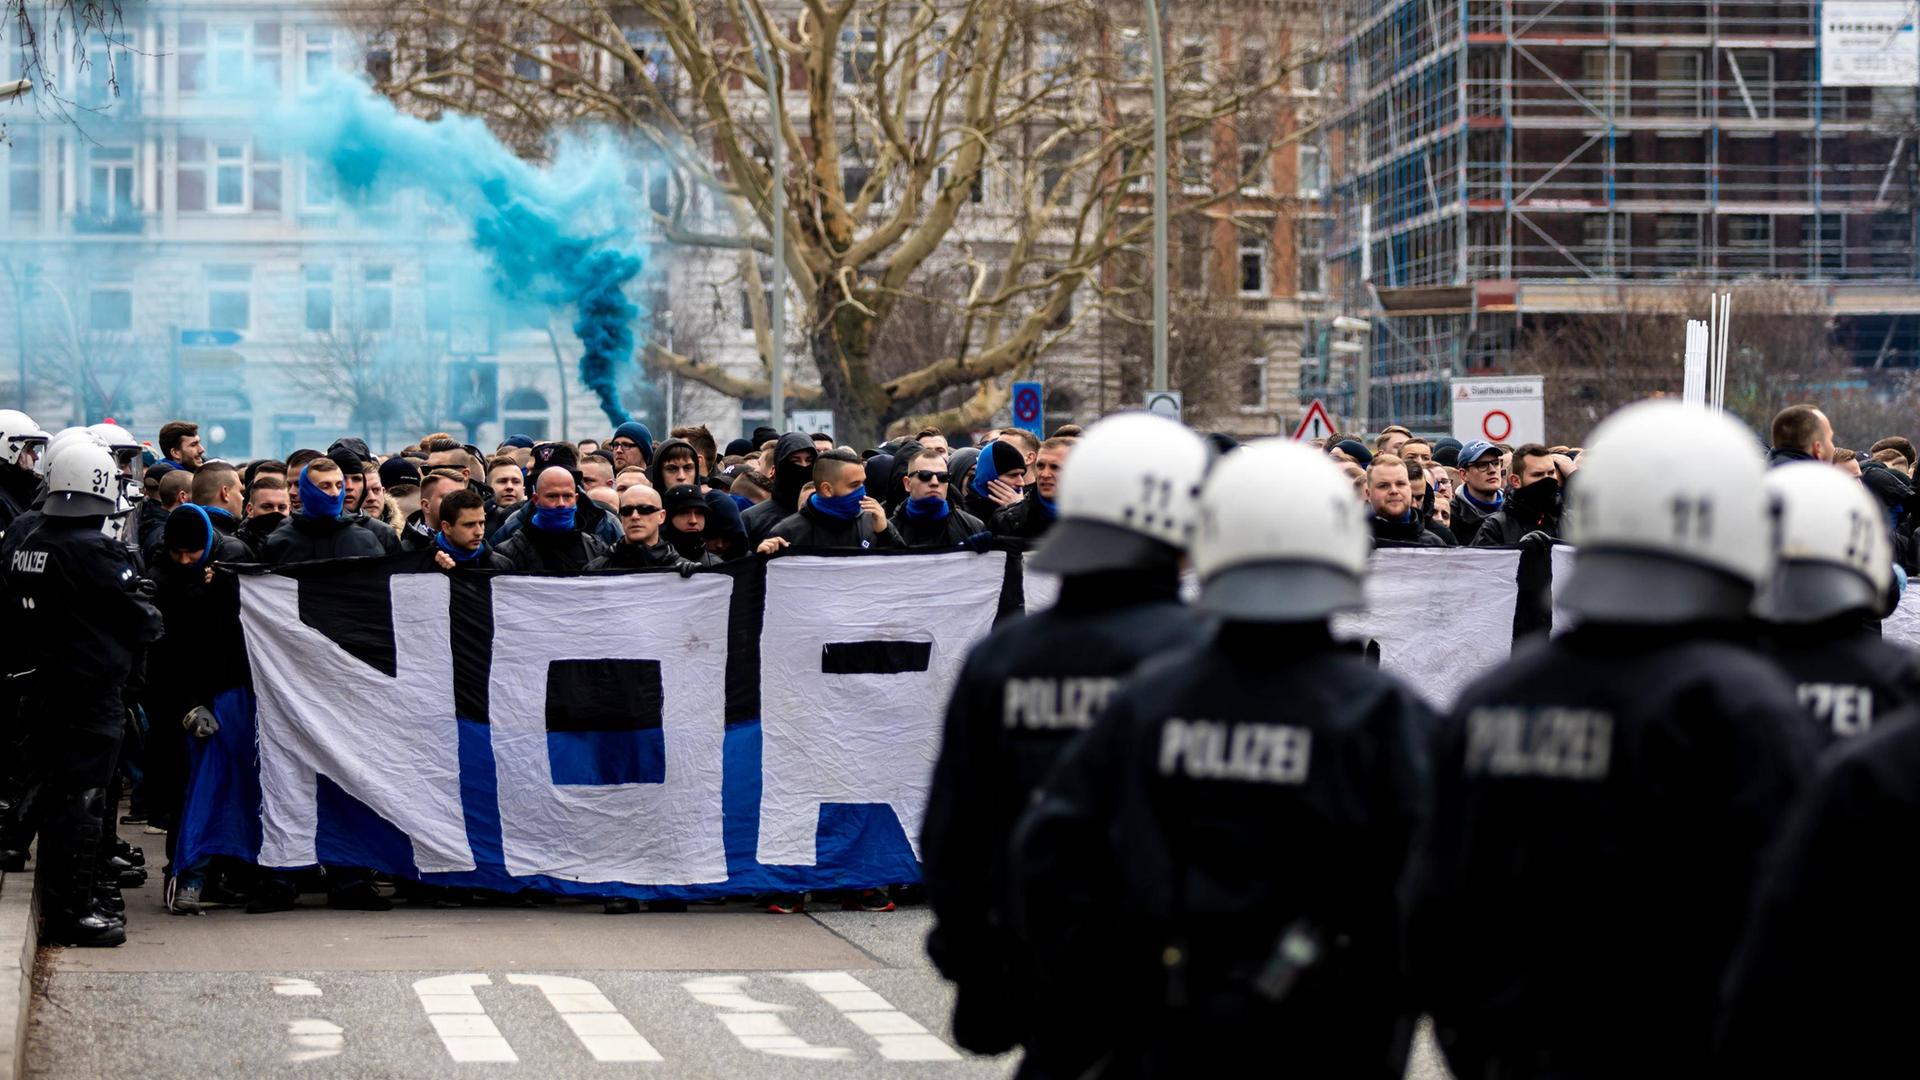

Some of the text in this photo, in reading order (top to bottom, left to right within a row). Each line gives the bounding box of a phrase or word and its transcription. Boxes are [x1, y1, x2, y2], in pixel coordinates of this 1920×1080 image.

[92, 468, 109, 488] 31
[11, 551, 48, 573] POLIZEI
[1003, 677, 1118, 730] POLIZE
[1159, 718, 1311, 784] POLIZEI
[1466, 707, 1613, 777] POLIZEI
